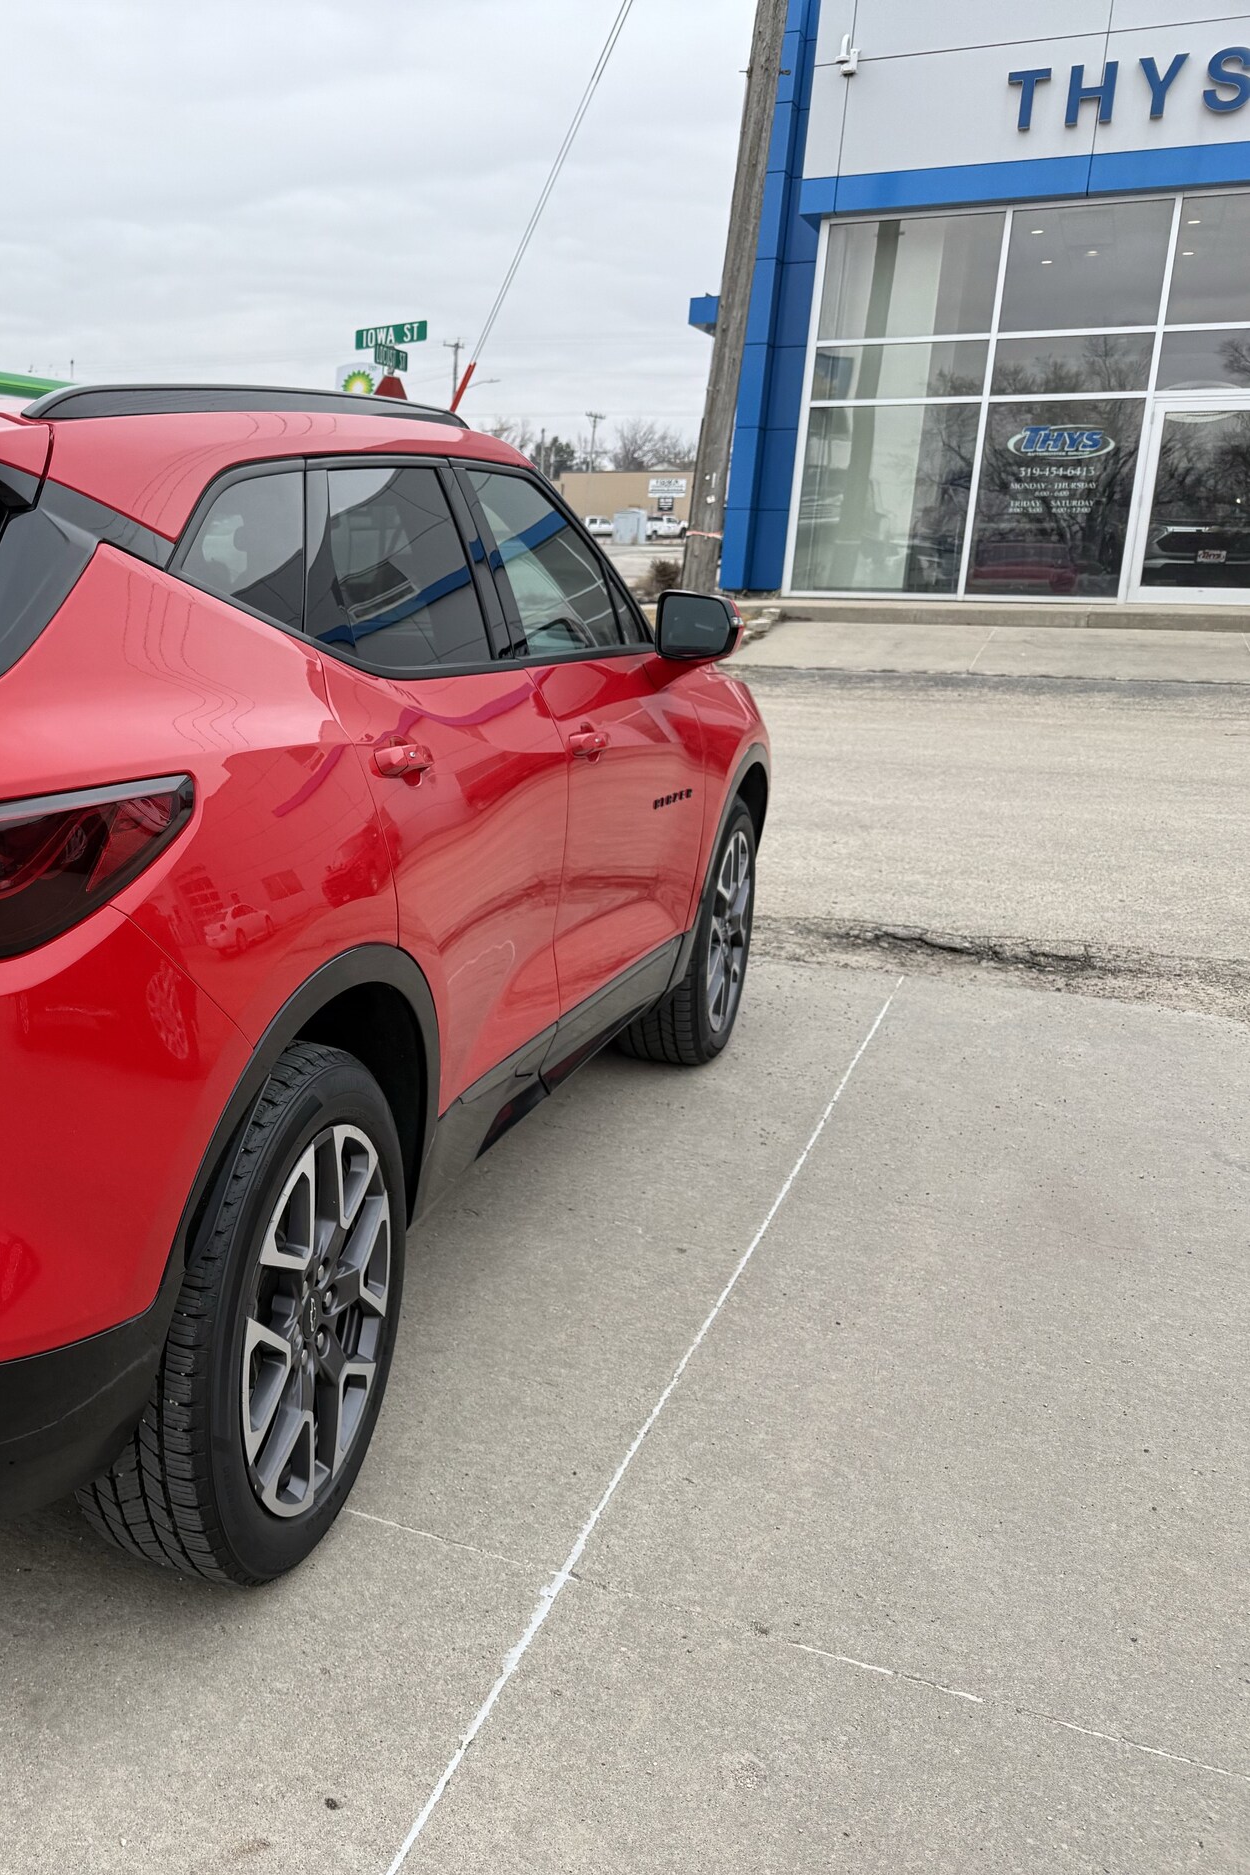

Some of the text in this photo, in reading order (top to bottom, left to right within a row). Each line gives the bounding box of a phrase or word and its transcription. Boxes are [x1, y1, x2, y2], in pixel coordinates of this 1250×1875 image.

[1008, 46, 1250, 131] THYS
[363, 323, 419, 348] IOWA ST
[1021, 426, 1104, 452] THYS
[1010, 482, 1047, 490] MONDAY
